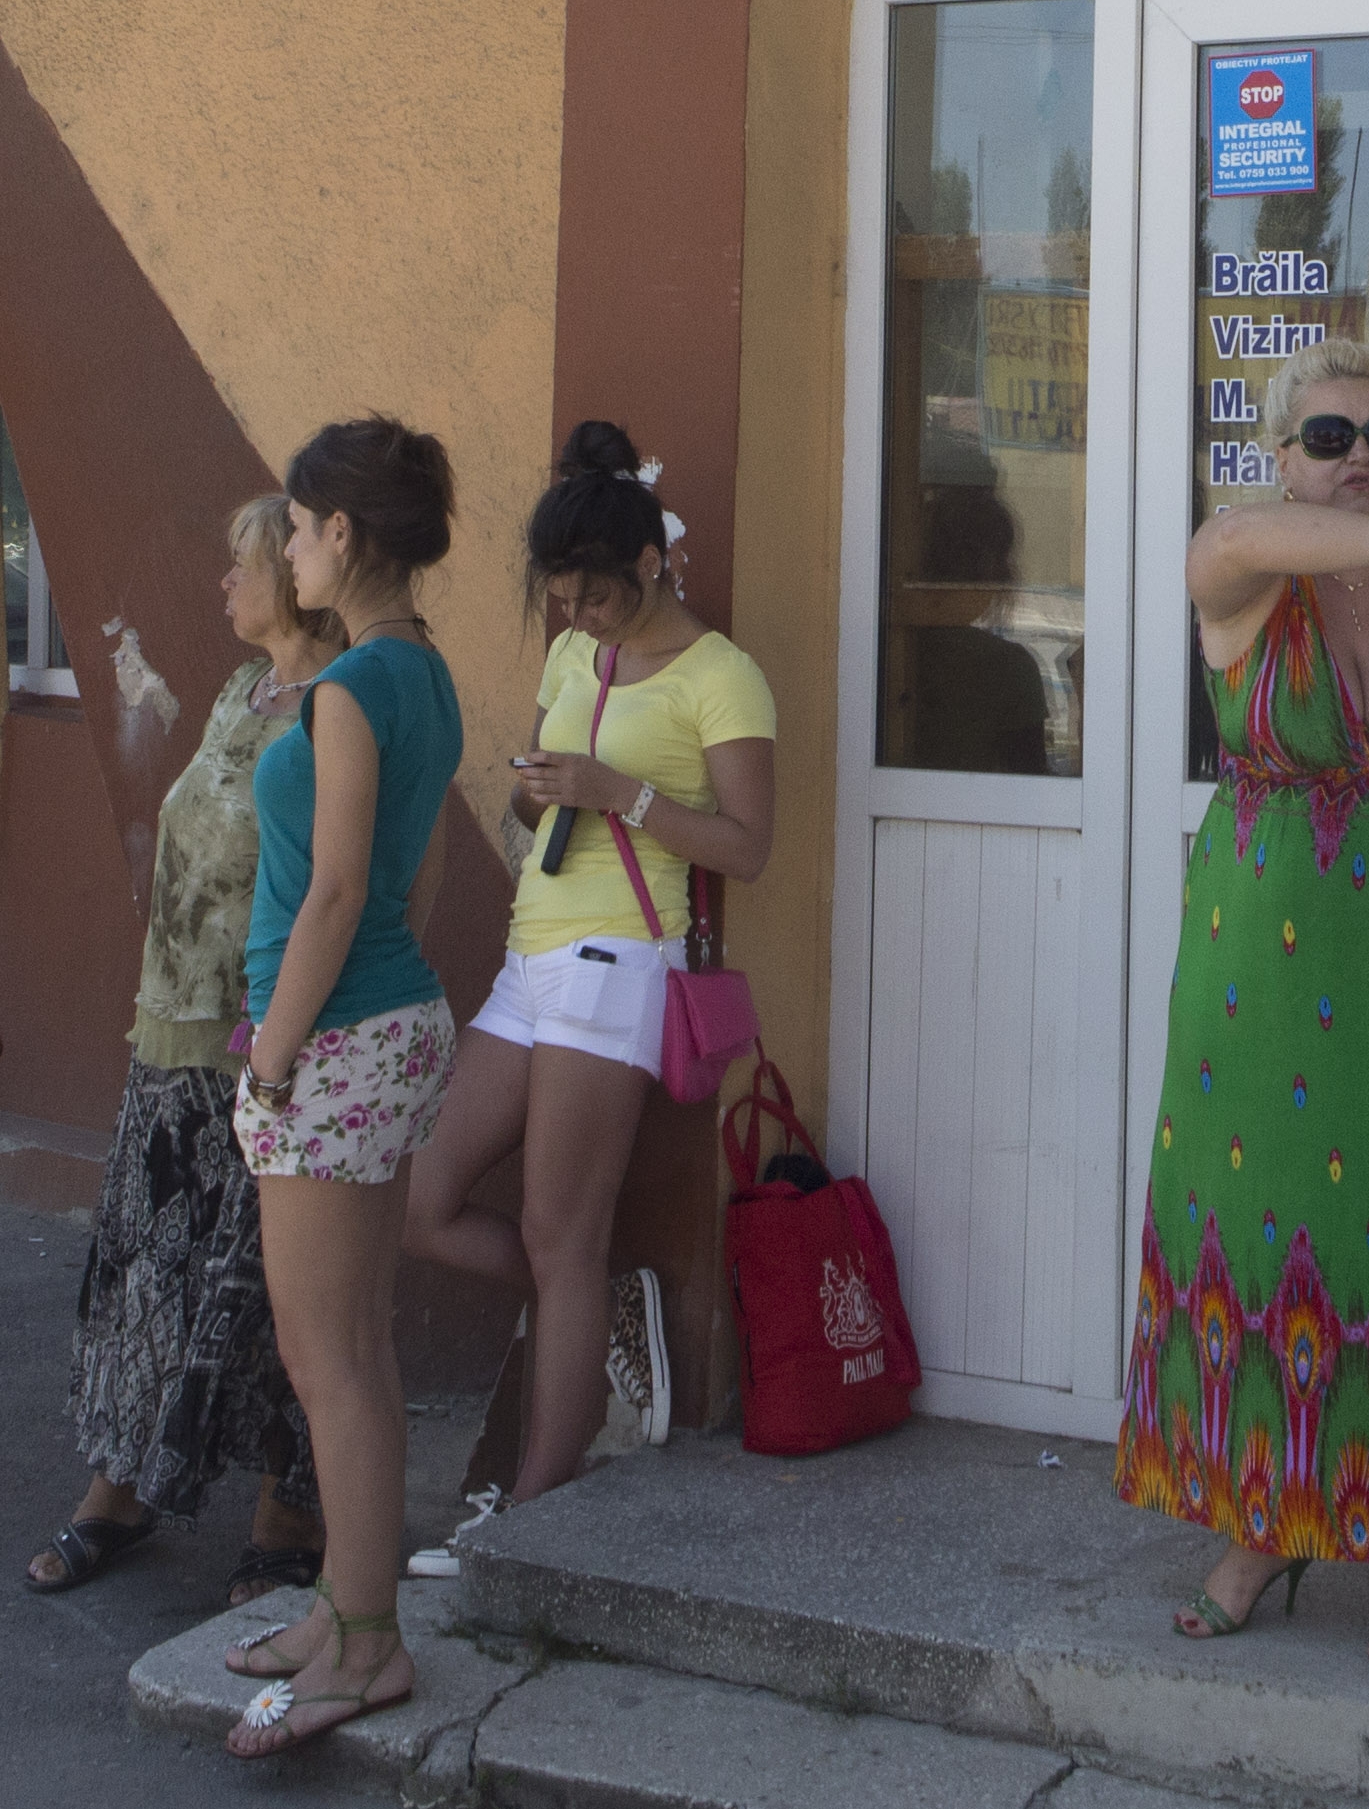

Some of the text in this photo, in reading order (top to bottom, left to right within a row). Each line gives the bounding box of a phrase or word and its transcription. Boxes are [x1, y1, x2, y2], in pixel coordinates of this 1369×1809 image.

[1216, 55, 1308, 69] OBIECTIV PROTEJAT
[1241, 85, 1283, 104] STOP
[1219, 121, 1306, 140] INTEGRAL
[1224, 138, 1301, 150] PROFESIONAL
[1219, 148, 1306, 167] SECURITY
[1218, 171, 1236, 179] Tel.
[1239, 168, 1265, 178] 0759
[1267, 167, 1287, 176] 033
[1212, 251, 1329, 297] Brăila
